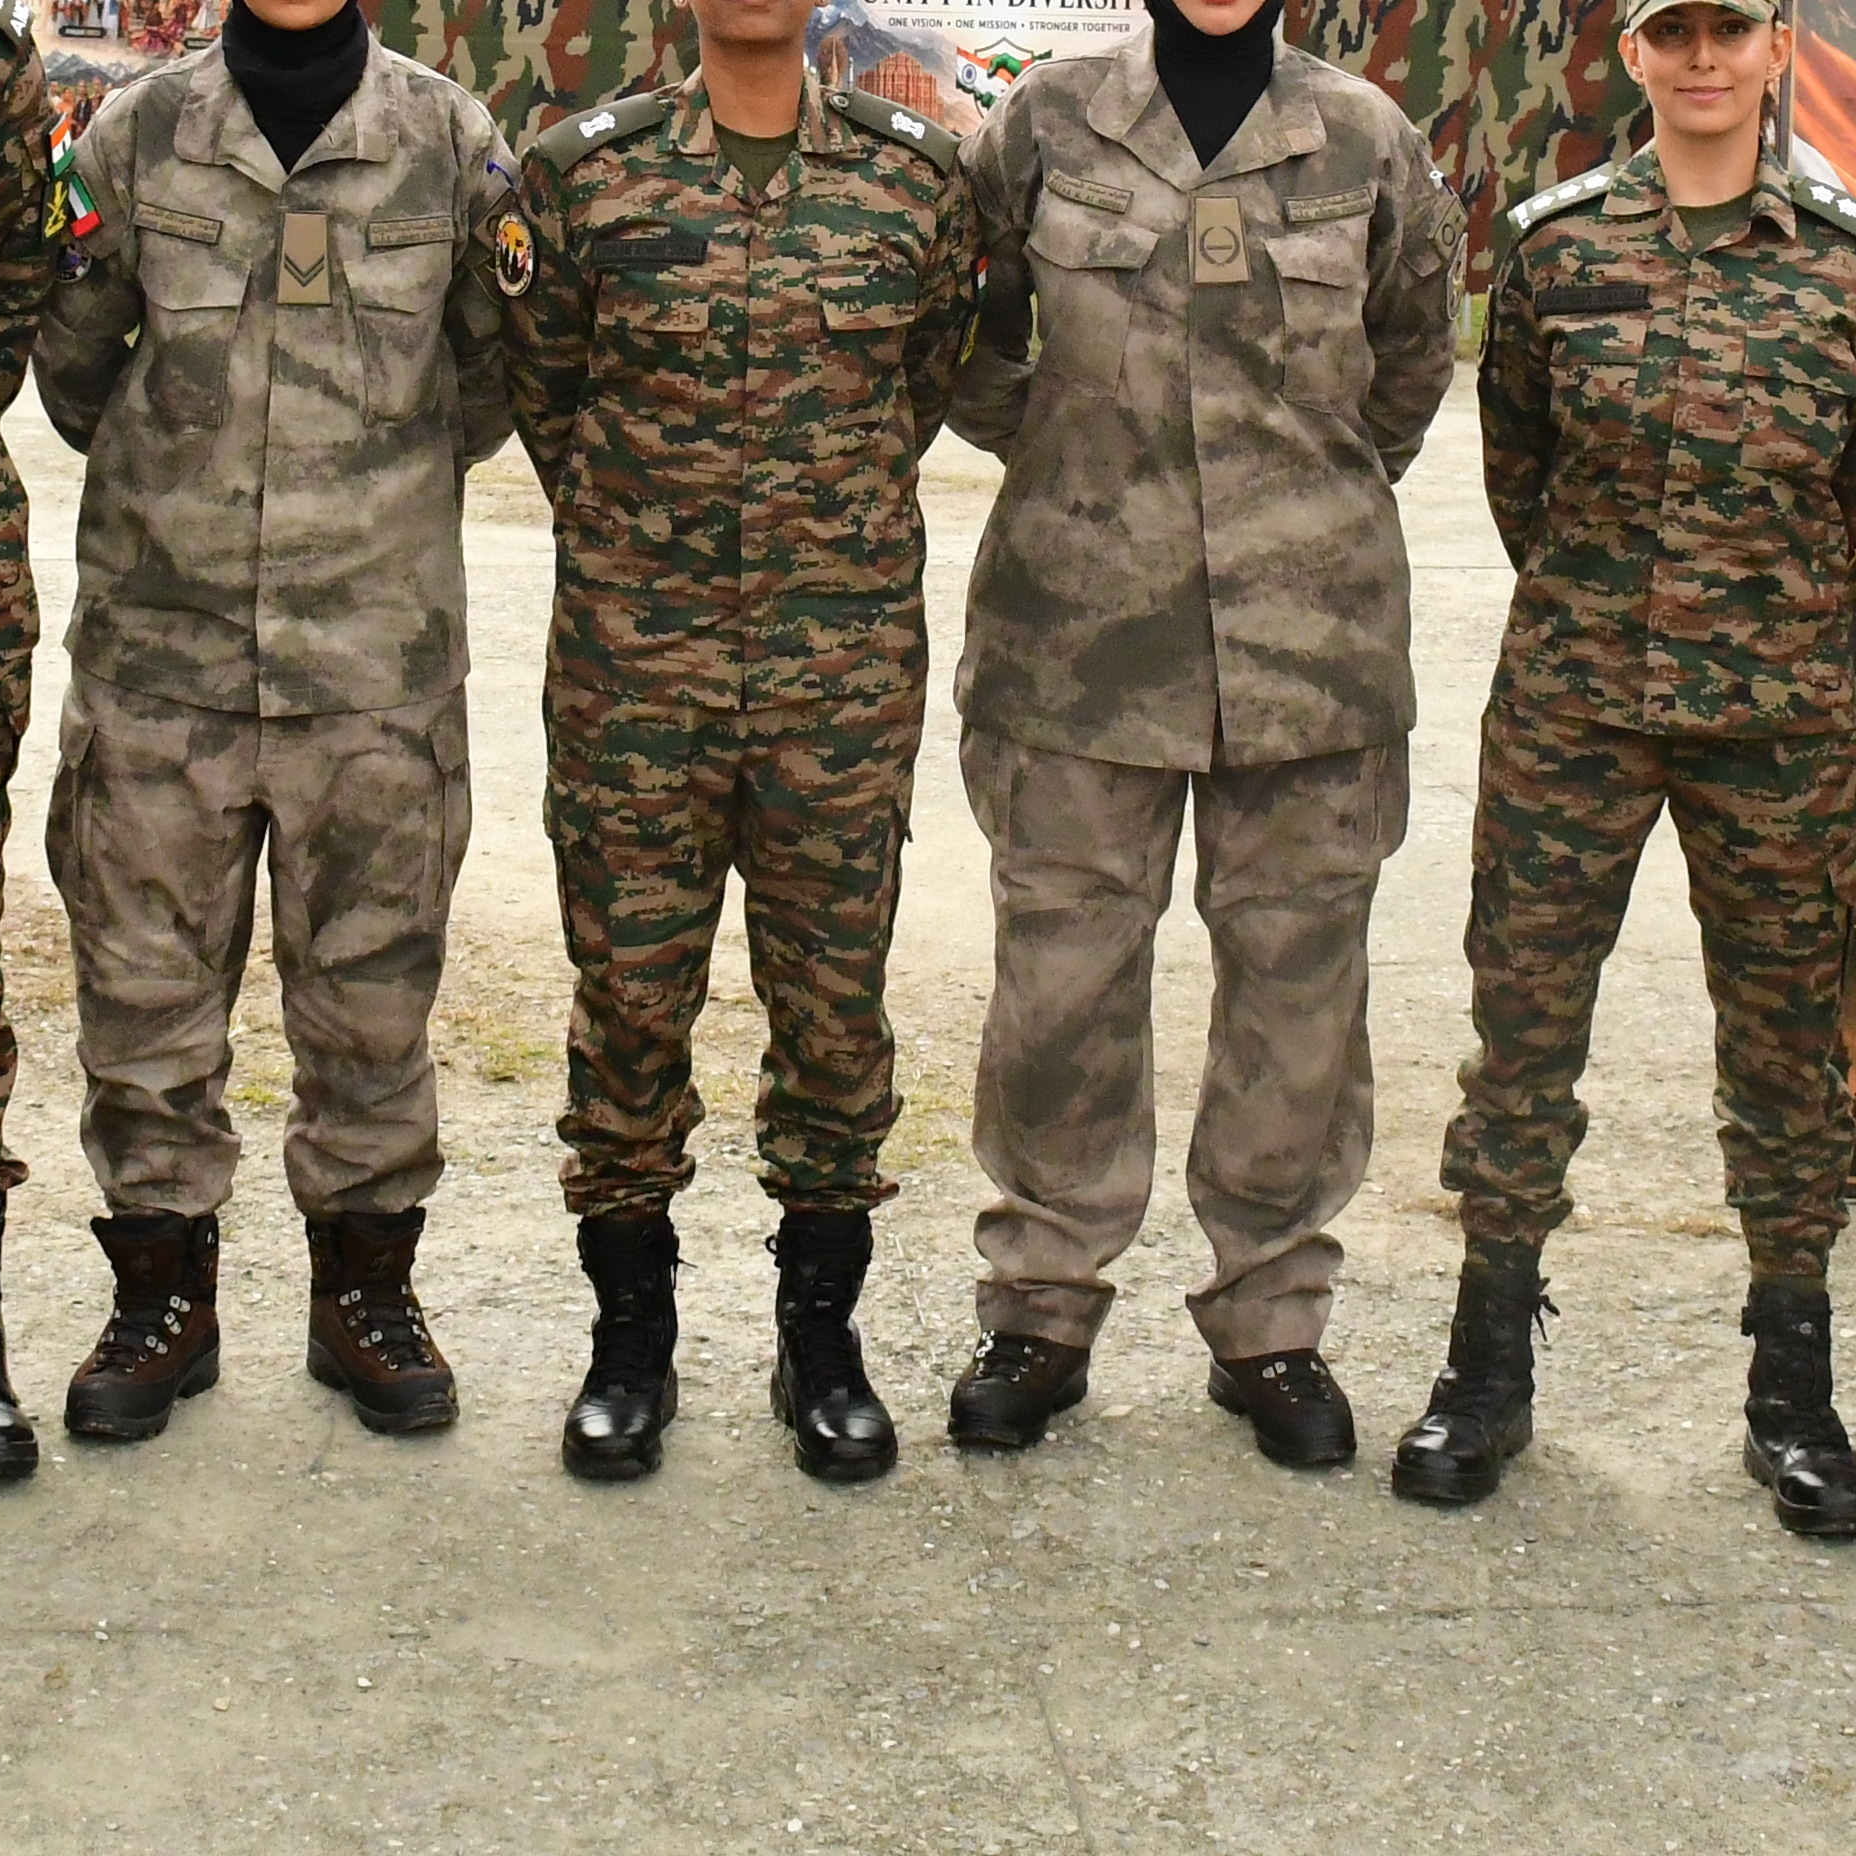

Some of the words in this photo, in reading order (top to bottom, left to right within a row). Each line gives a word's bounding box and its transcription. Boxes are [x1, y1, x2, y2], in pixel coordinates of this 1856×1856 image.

[888, 17, 909, 28] ONE
[911, 18, 943, 29] VISION
[955, 19, 975, 30] ONE
[978, 20, 1017, 31] MISSION
[1029, 21, 1079, 32] STRONGER
[1082, 23, 1131, 33] TOGETHER
